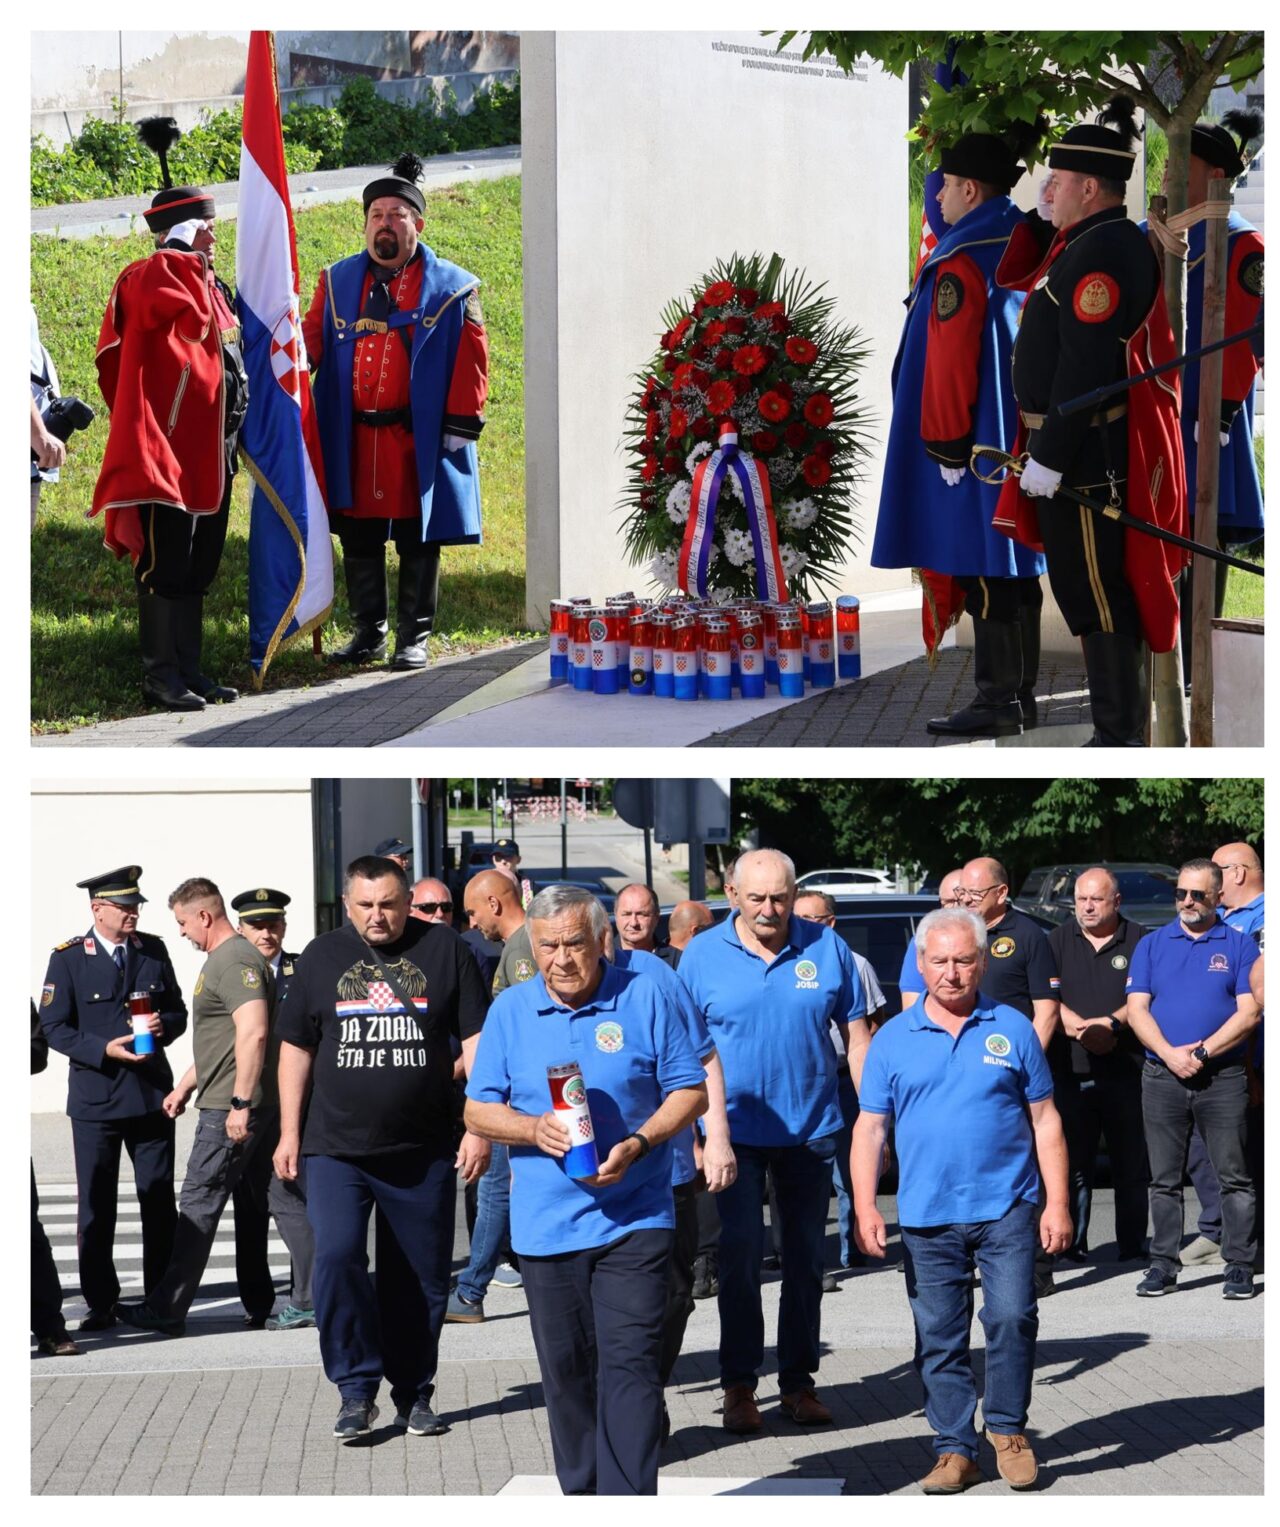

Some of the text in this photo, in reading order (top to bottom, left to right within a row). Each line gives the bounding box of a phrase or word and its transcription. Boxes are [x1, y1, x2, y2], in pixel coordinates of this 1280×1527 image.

[795, 981, 819, 990] JOSIP
[340, 1017, 361, 1043] JA
[337, 1044, 426, 1068] ŠTA JE BILO
